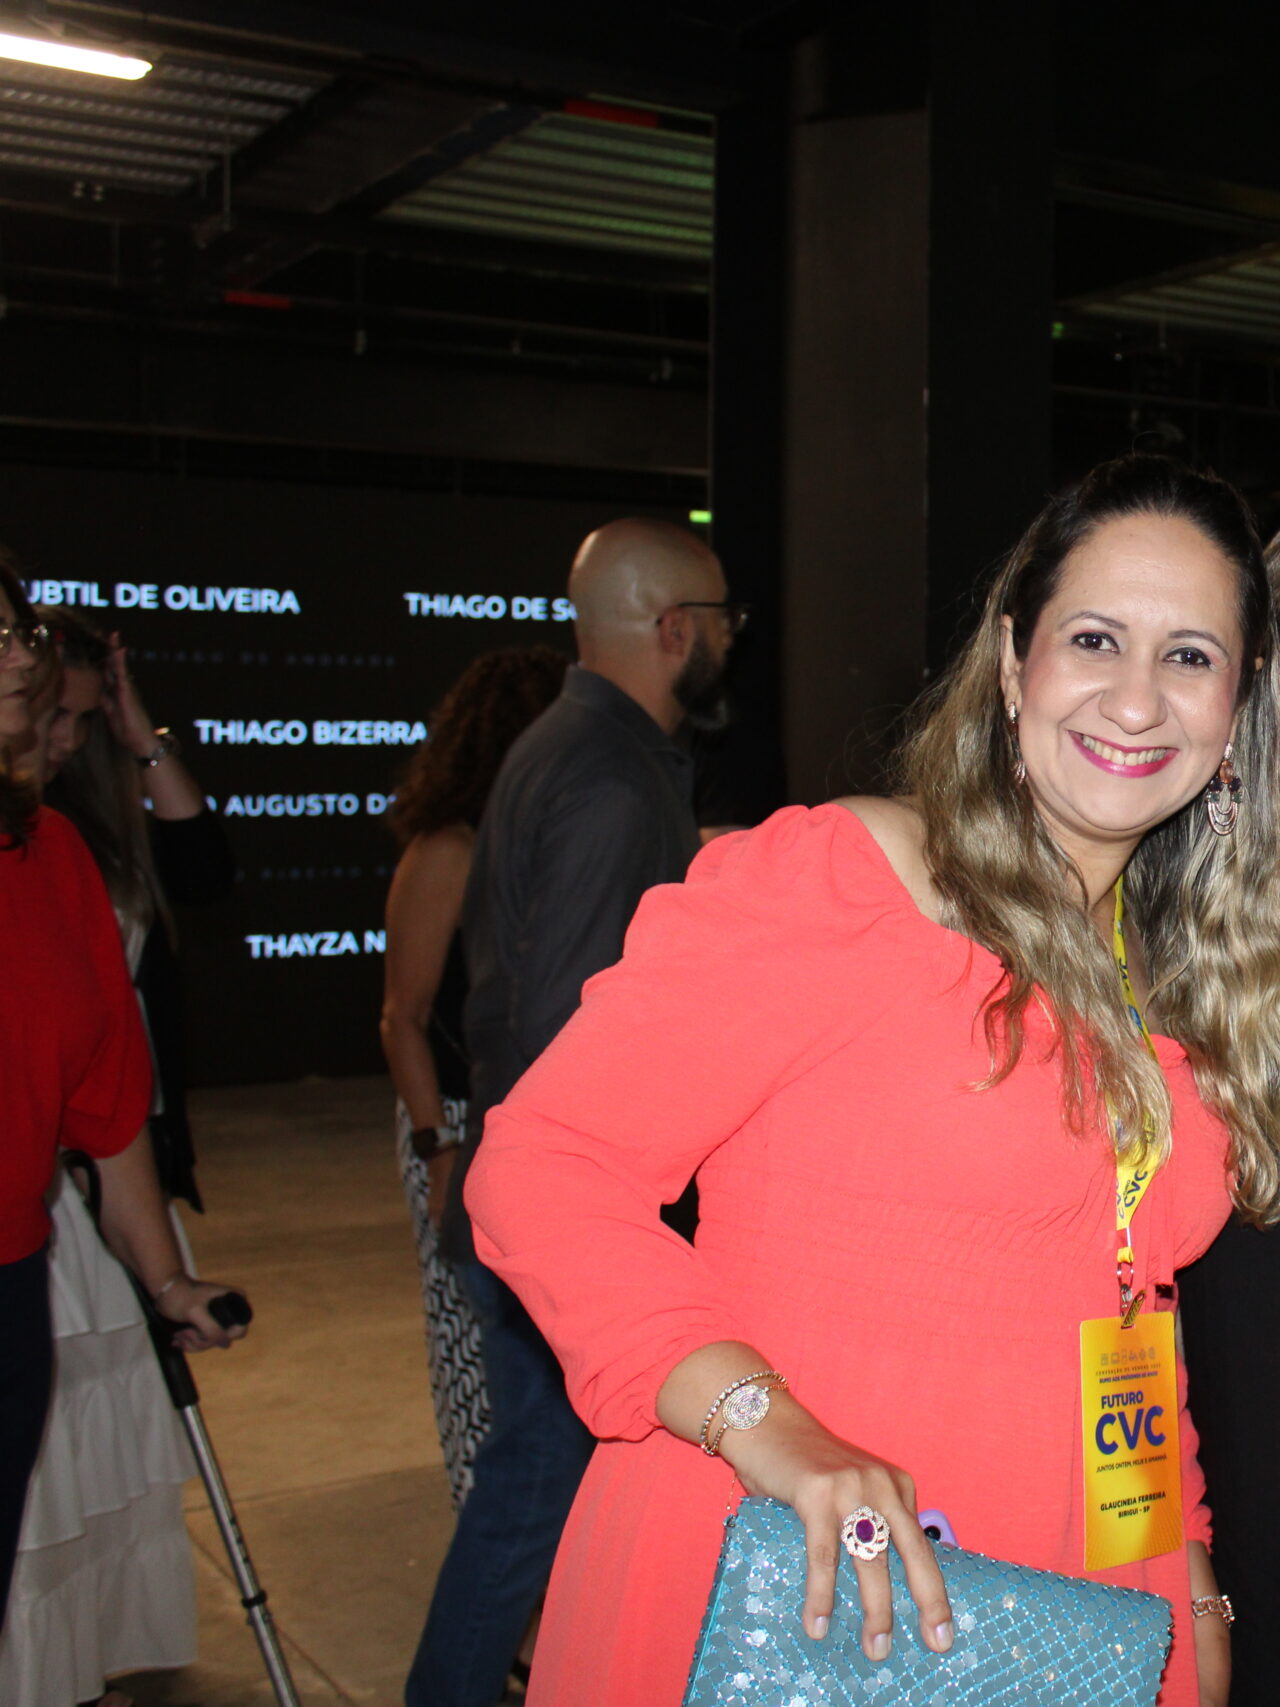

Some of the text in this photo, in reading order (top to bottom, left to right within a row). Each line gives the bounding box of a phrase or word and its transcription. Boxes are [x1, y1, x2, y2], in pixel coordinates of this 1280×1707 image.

[115, 582, 159, 609] DE
[164, 585, 300, 614] OLIVEIRA
[403, 592, 507, 619] THIAGO
[511, 596, 548, 621] DE
[194, 719, 427, 745] THIAGO BIZERRA
[224, 793, 358, 817] AUGUSTO
[245, 932, 358, 959] THAYZA
[1124, 1169, 1148, 1207] CVC
[1101, 1391, 1144, 1409] FUTURO
[1096, 1405, 1166, 1455] CVC
[1100, 1491, 1166, 1512] GLAUCINEIA FERREIRA
